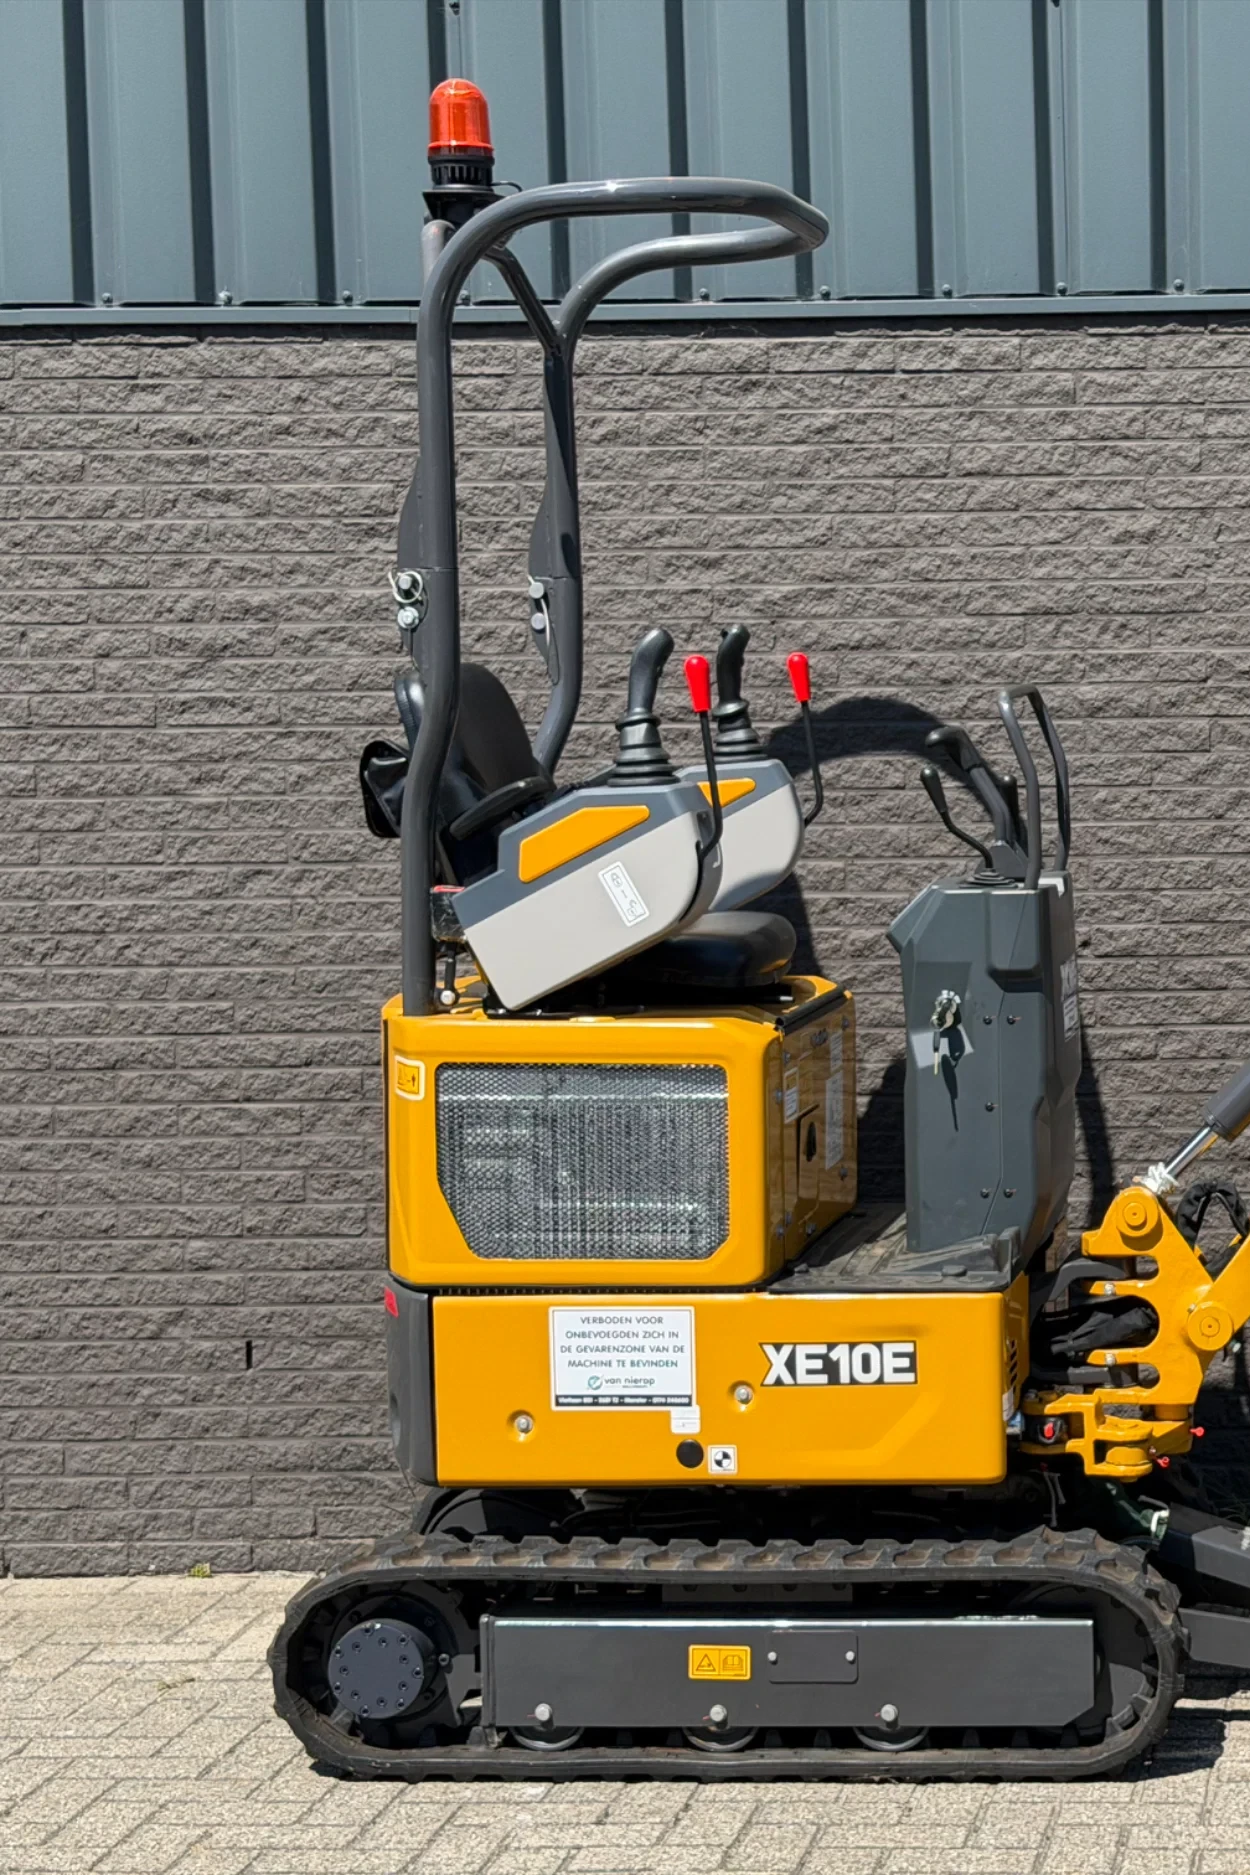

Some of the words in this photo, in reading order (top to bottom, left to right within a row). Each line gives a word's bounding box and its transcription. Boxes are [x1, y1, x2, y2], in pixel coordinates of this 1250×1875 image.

[580, 1316, 632, 1325] VERBODEN
[635, 1316, 664, 1325] VOOR
[565, 1330, 640, 1339] ONBEVOEGDEN
[642, 1330, 665, 1339] ZICH
[668, 1330, 679, 1339] IN
[560, 1345, 572, 1354] DE
[576, 1345, 646, 1354] GEVARENZONE
[649, 1345, 670, 1354] VAN
[673, 1345, 686, 1354] DE
[567, 1359, 613, 1368] MACHINE
[616, 1359, 626, 1368] TE
[630, 1359, 678, 1368] BEVINDEN
[762, 1343, 916, 1385] XE10E
[624, 1376, 656, 1387] nierop
